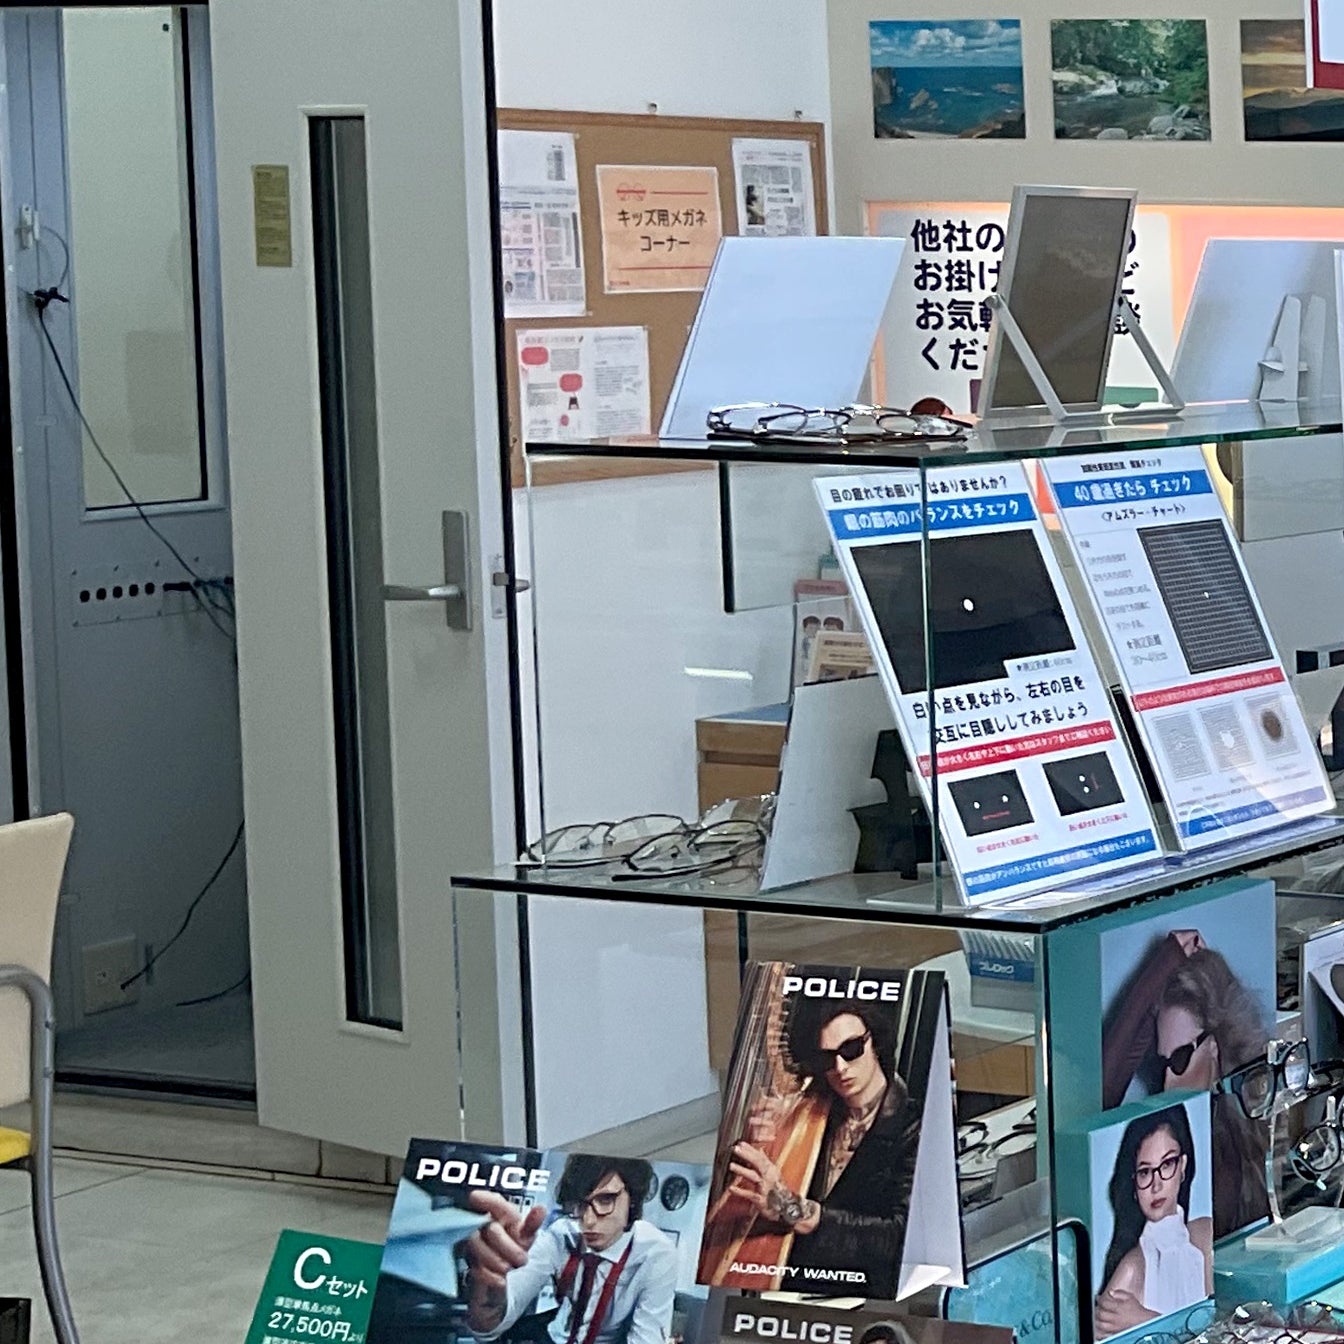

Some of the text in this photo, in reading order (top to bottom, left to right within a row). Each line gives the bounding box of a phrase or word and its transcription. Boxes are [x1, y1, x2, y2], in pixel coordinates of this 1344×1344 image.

[618, 209, 707, 226] キッズ用メガネ
[640, 236, 690, 252] コーナー
[912, 219, 1004, 252] 他社の
[922, 337, 988, 370] くだ
[1150, 474, 1191, 494] チェック
[935, 702, 1088, 744] 交互に目隠ししてみましょう
[783, 977, 901, 1002] POLICE
[416, 1158, 551, 1192] POLICE
[294, 1247, 368, 1299] Cセット
[730, 1261, 799, 1277] AUDACITY
[734, 1313, 853, 1344] POLICE
